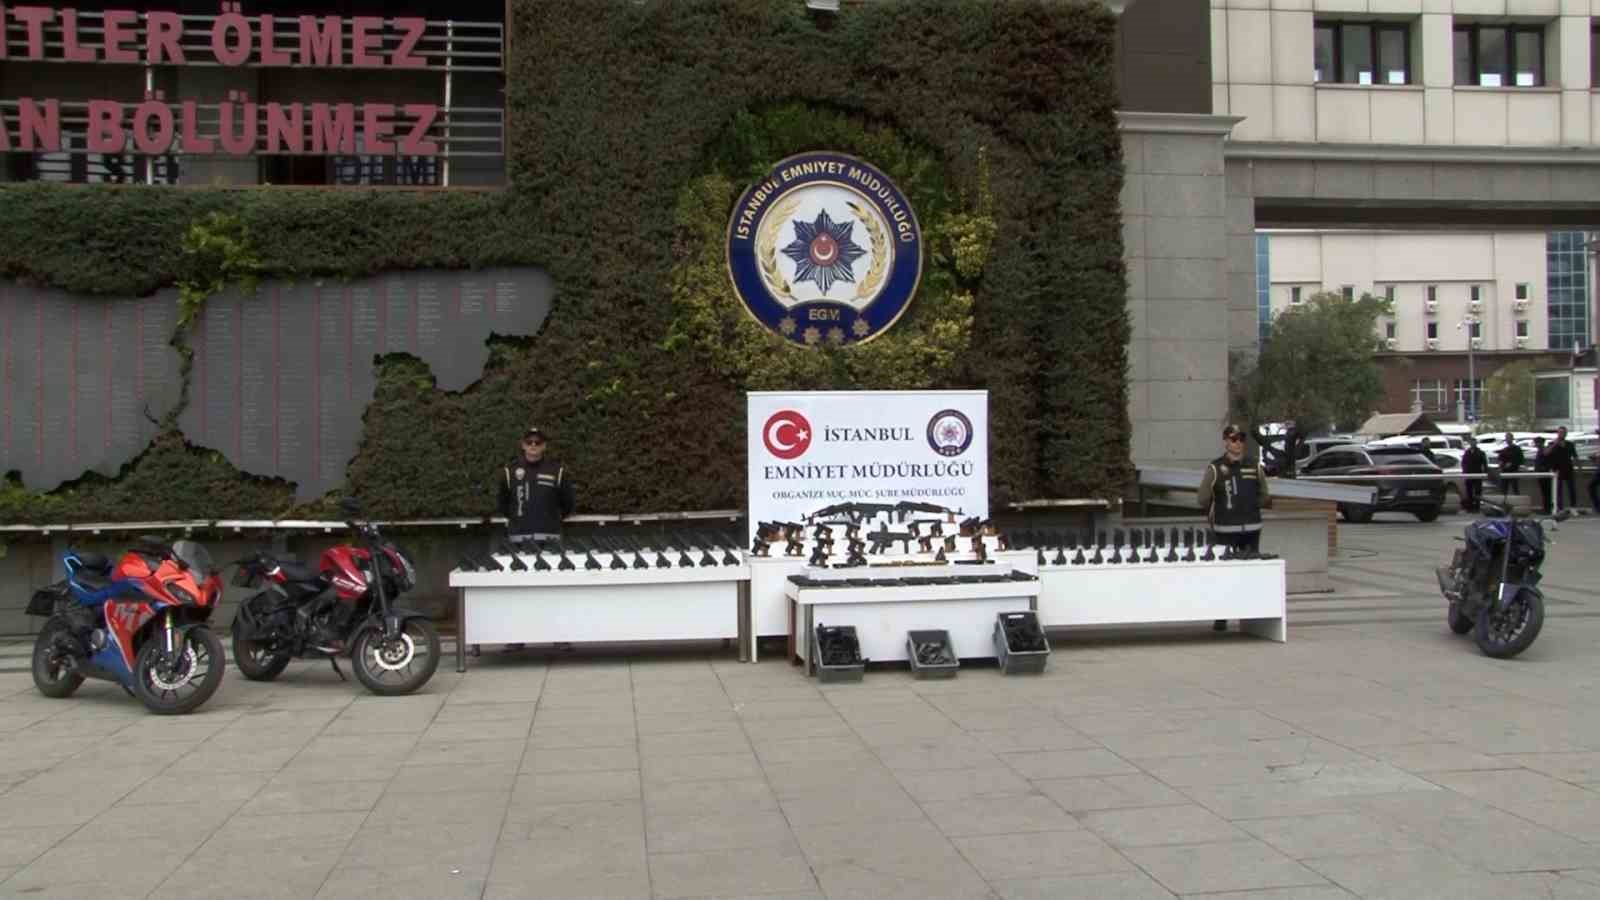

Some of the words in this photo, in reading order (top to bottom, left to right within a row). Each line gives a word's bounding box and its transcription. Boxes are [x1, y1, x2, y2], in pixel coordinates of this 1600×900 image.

[211, 2, 428, 67] ÖLMEZ
[0, 97, 60, 152] N
[87, 90, 439, 155] BÖLÜNMEZ
[824, 425, 914, 442] İSTANBUL
[764, 462, 848, 480] EMNİYET
[852, 460, 974, 479] MÜDÜRLÜĞÜ
[772, 488, 823, 499] ORGANİZE
[901, 486, 966, 497] MÜDÜRLÜĞÜ
